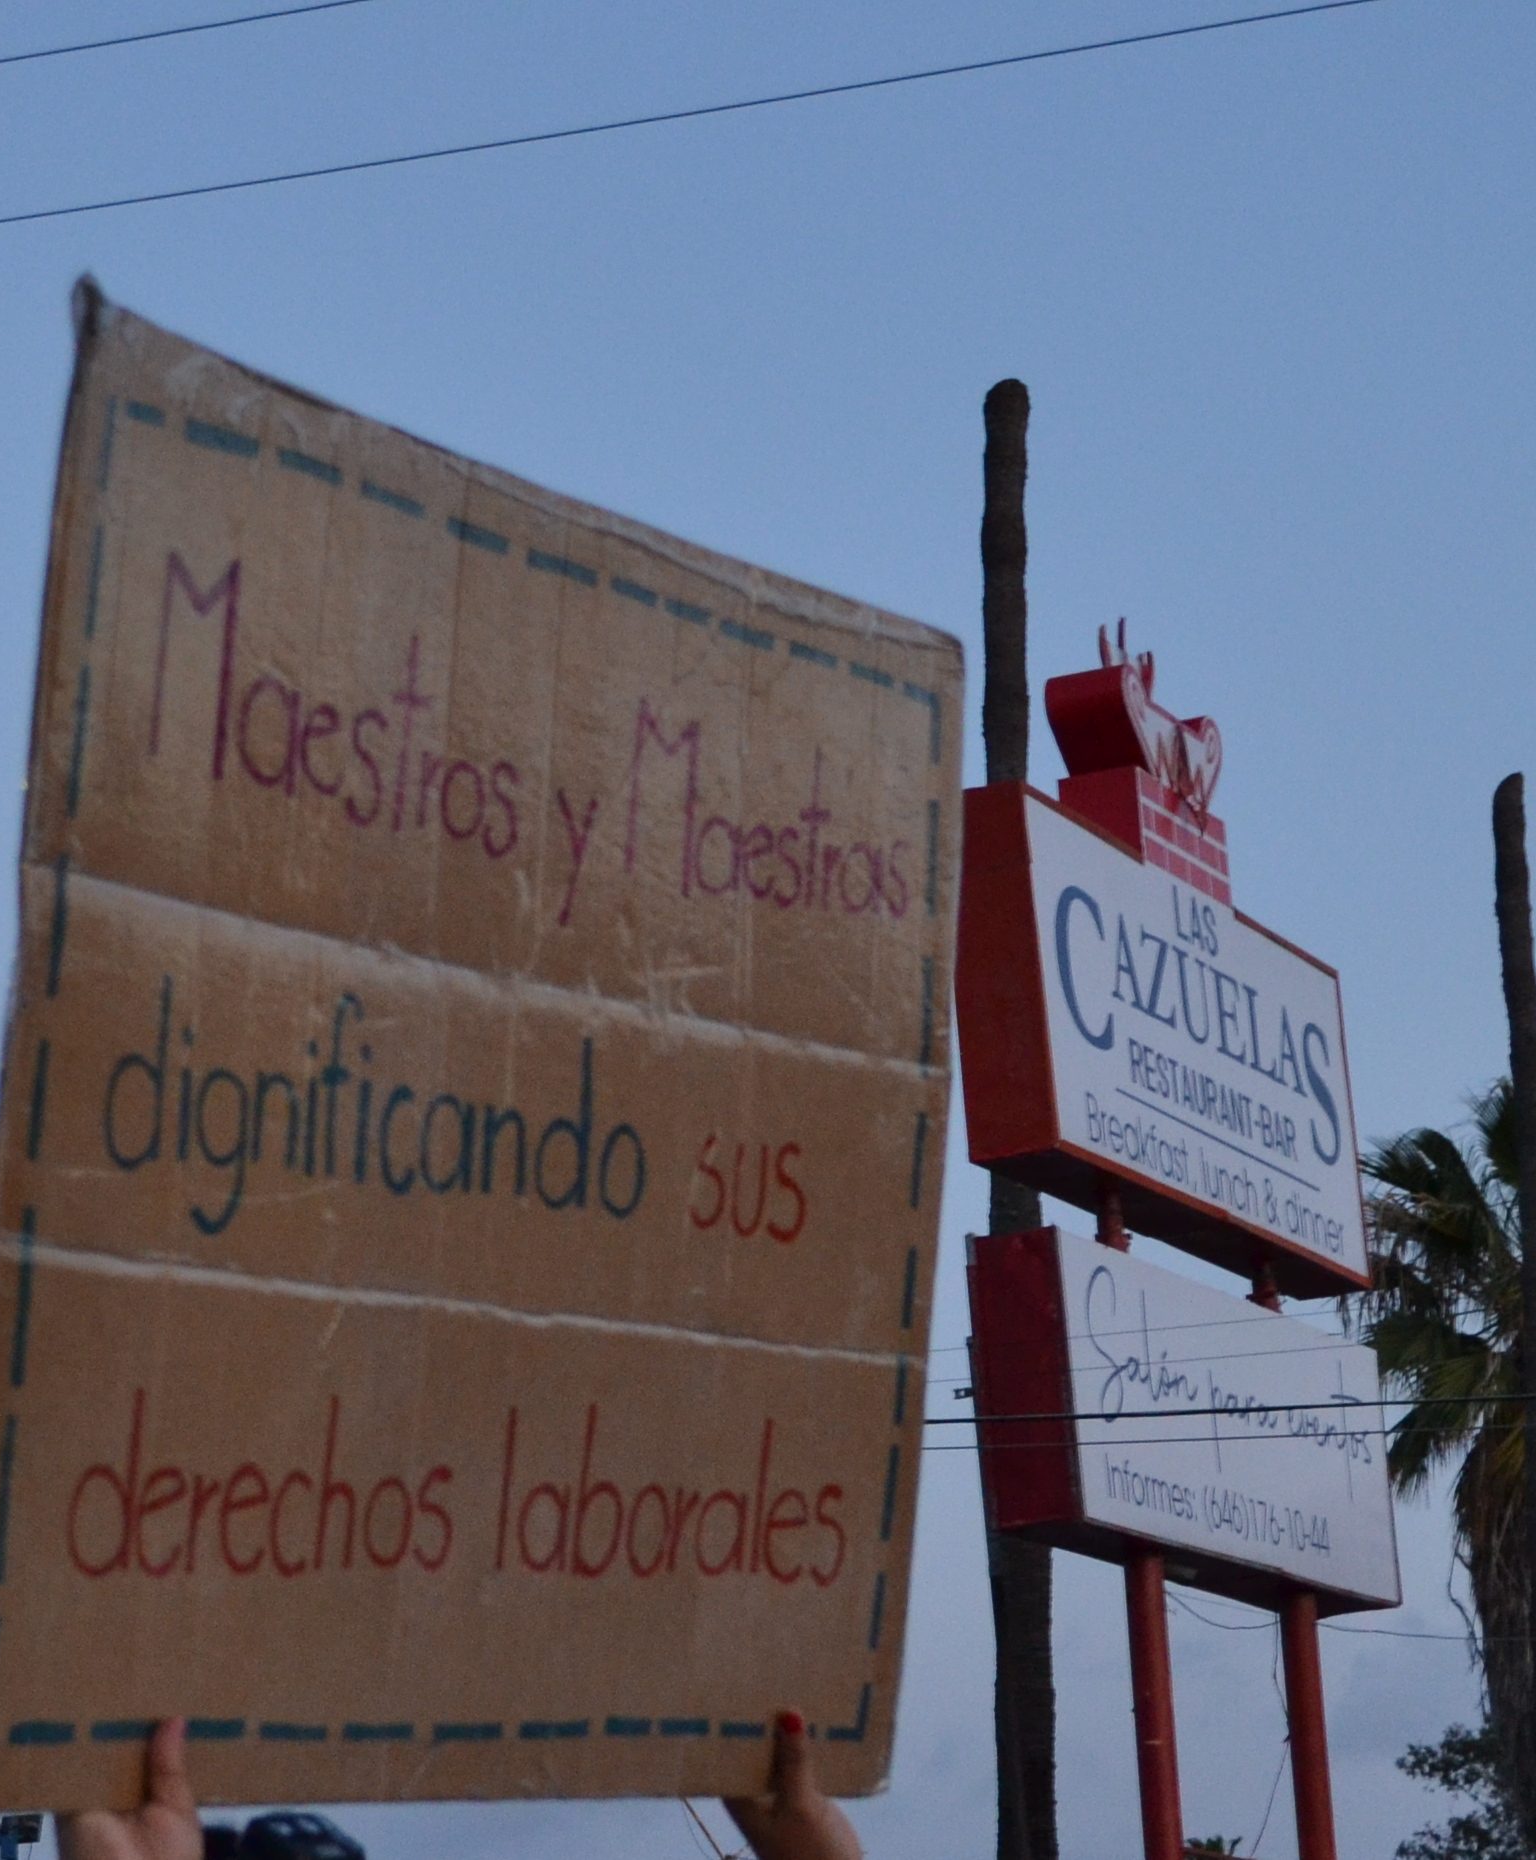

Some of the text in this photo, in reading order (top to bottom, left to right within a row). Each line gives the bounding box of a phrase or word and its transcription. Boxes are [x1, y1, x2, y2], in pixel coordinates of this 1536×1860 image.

[148, 551, 910, 924] Maestros y Maestras
[1173, 884, 1219, 957] LAS
[1055, 885, 1341, 1166] CAZUELAS
[1128, 1038, 1298, 1161] RESTAURANT-BAR
[102, 974, 807, 1242] dignificando sus
[1200, 1147, 1259, 1217] lunch
[1263, 1178, 1281, 1226] &
[1285, 1193, 1345, 1256] dinner
[66, 1388, 847, 1587] derechos laborales
[1105, 1453, 1198, 1521] Informes:
